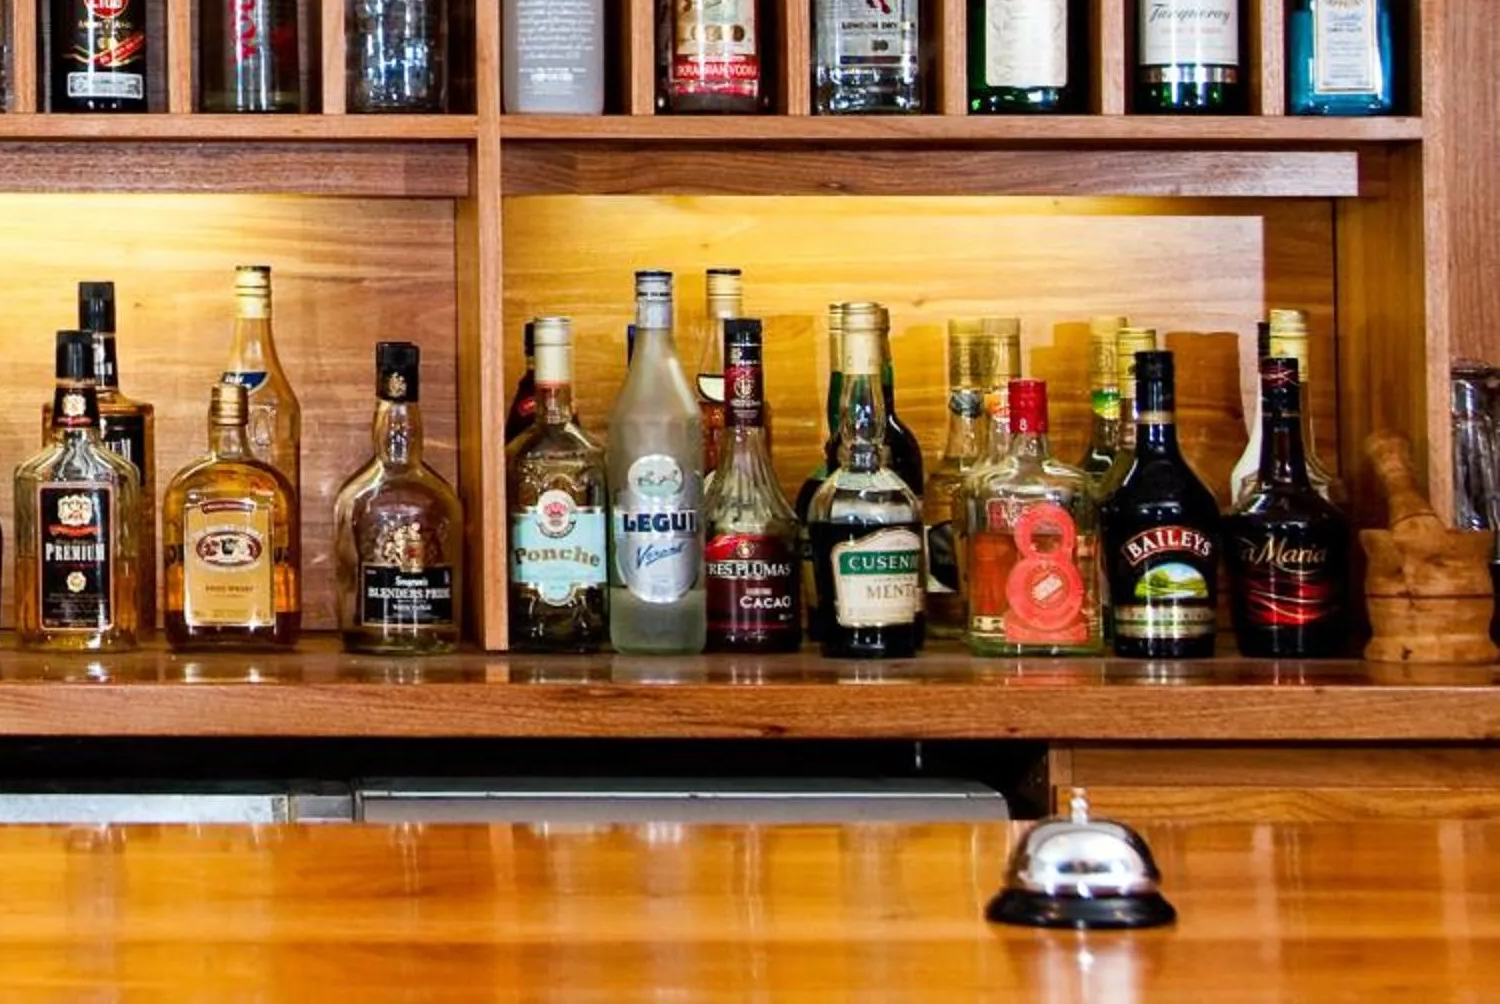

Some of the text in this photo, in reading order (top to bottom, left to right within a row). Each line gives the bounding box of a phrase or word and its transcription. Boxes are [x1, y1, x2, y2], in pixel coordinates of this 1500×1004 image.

[623, 512, 694, 533] LEGUI
[45, 542, 105, 562] PREMIUM
[1127, 530, 1210, 558] BAILEYS
[514, 546, 600, 568] Ponche
[739, 595, 791, 609] CACAO
